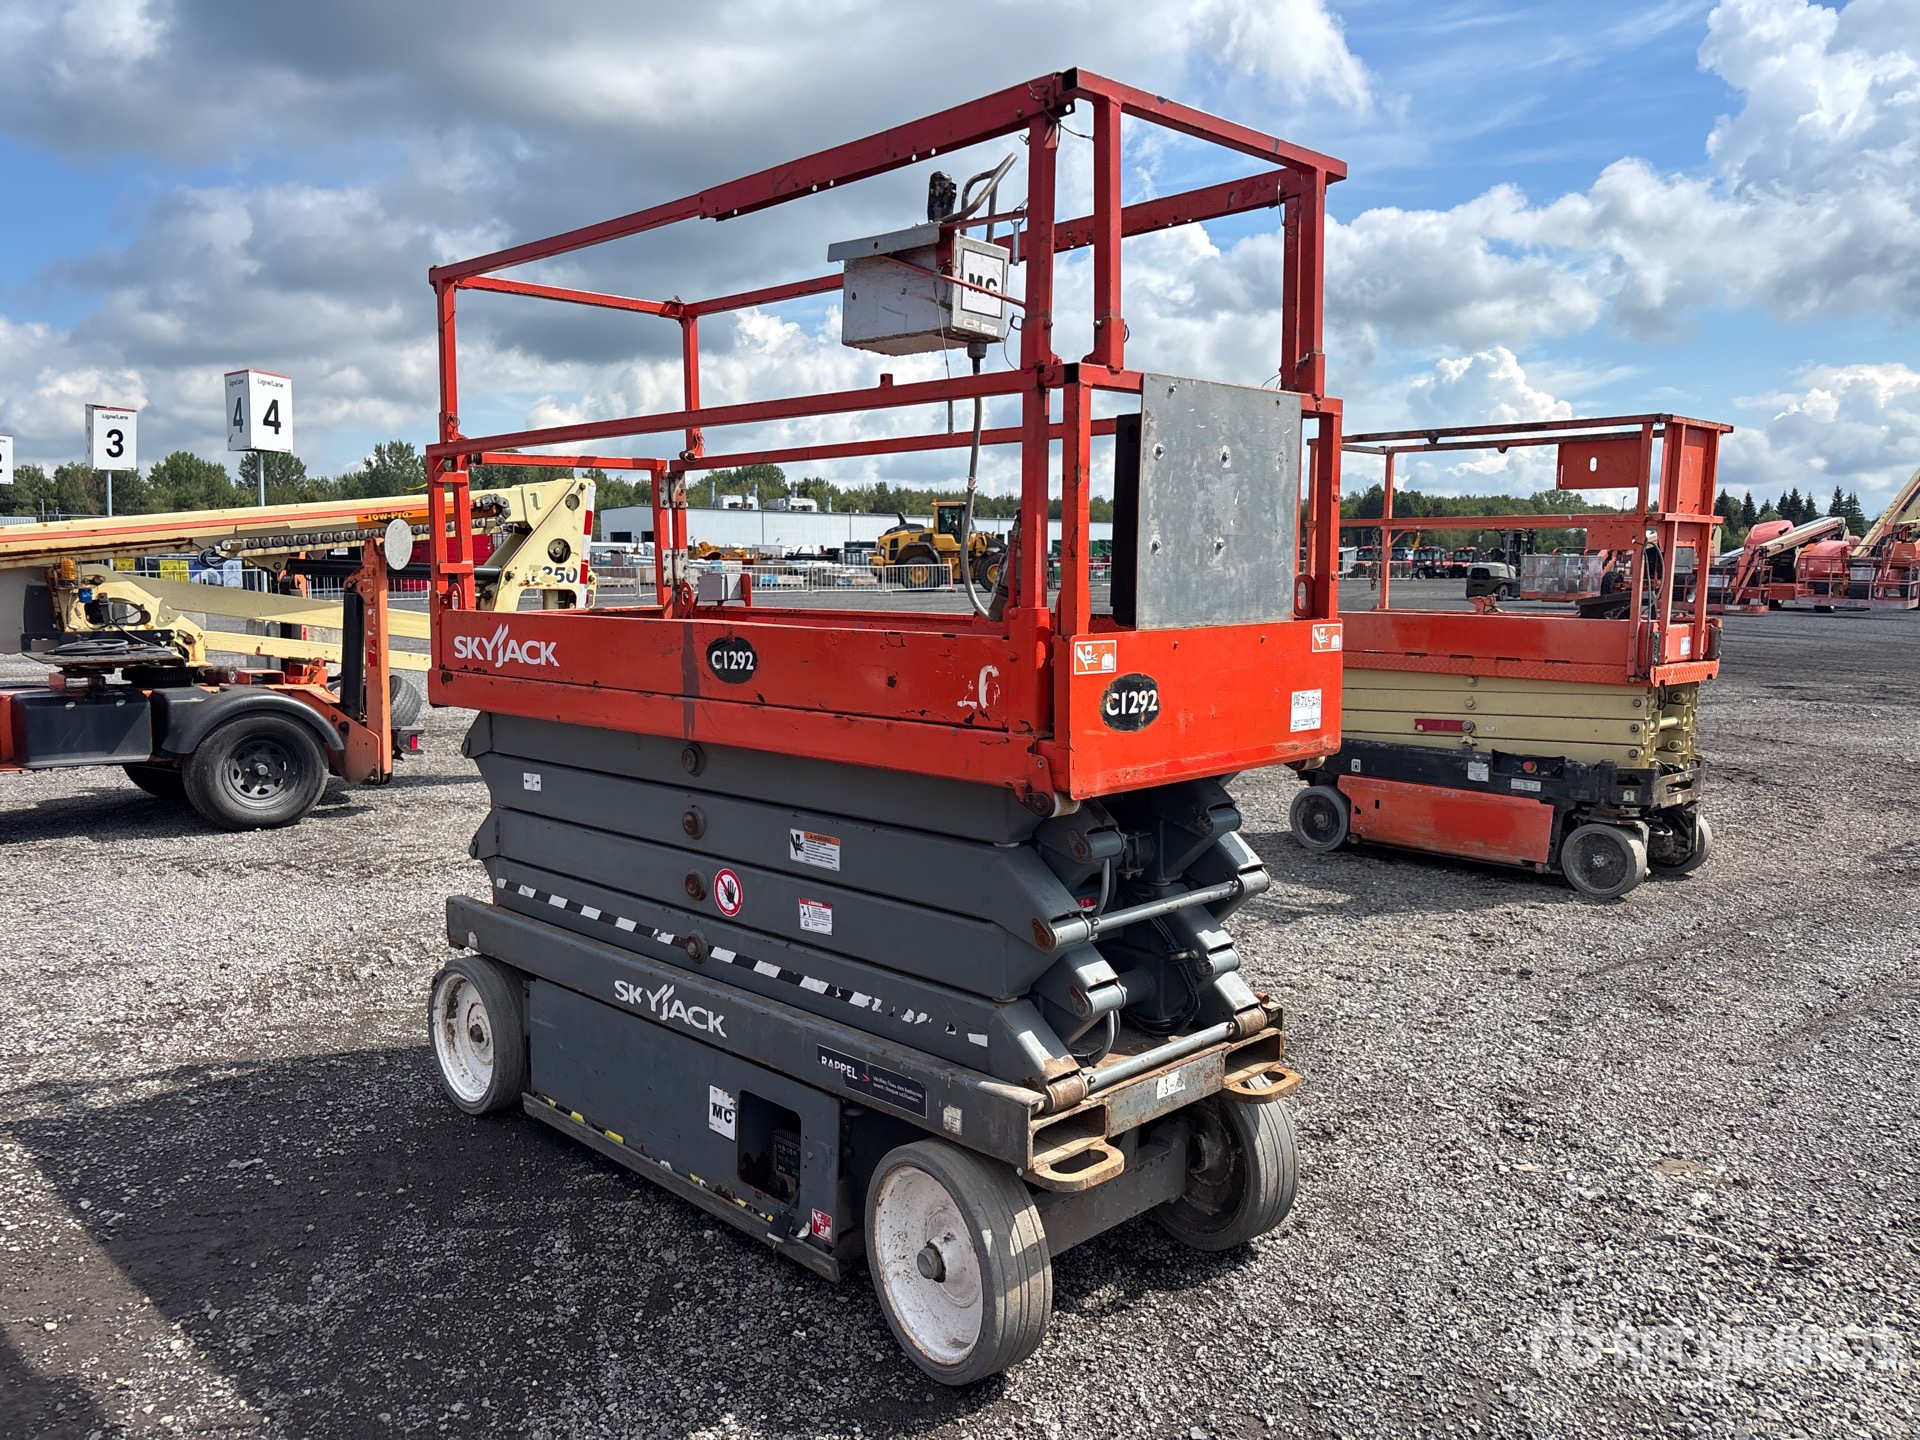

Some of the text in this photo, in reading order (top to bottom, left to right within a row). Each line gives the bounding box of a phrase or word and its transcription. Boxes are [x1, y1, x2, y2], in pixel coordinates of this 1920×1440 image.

[257, 378, 284, 388] Ligne/Lane
[232, 397, 244, 433] 4
[263, 399, 281, 435] 4
[106, 429, 124, 458] 3
[453, 623, 560, 668] SKYJACK
[712, 650, 754, 671] C1292
[1105, 689, 1158, 717] C1292
[614, 979, 728, 1039] SKYJACK
[821, 1056, 858, 1080] RAPPEL
[712, 1105, 732, 1124] MC
